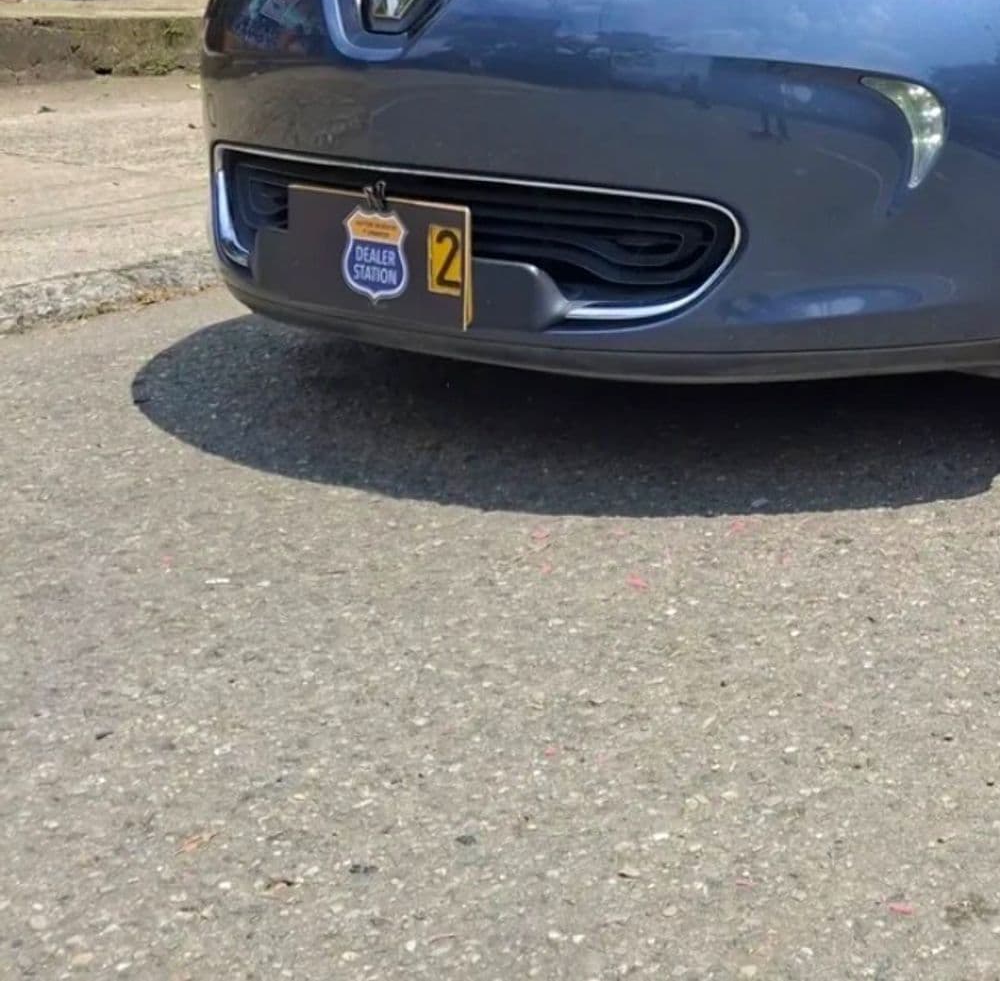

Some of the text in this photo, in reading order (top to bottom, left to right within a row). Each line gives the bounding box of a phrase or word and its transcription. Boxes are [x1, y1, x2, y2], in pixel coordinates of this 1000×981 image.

[354, 245, 397, 267] DEALER
[435, 230, 460, 287] 2
[352, 263, 398, 285] STATION
